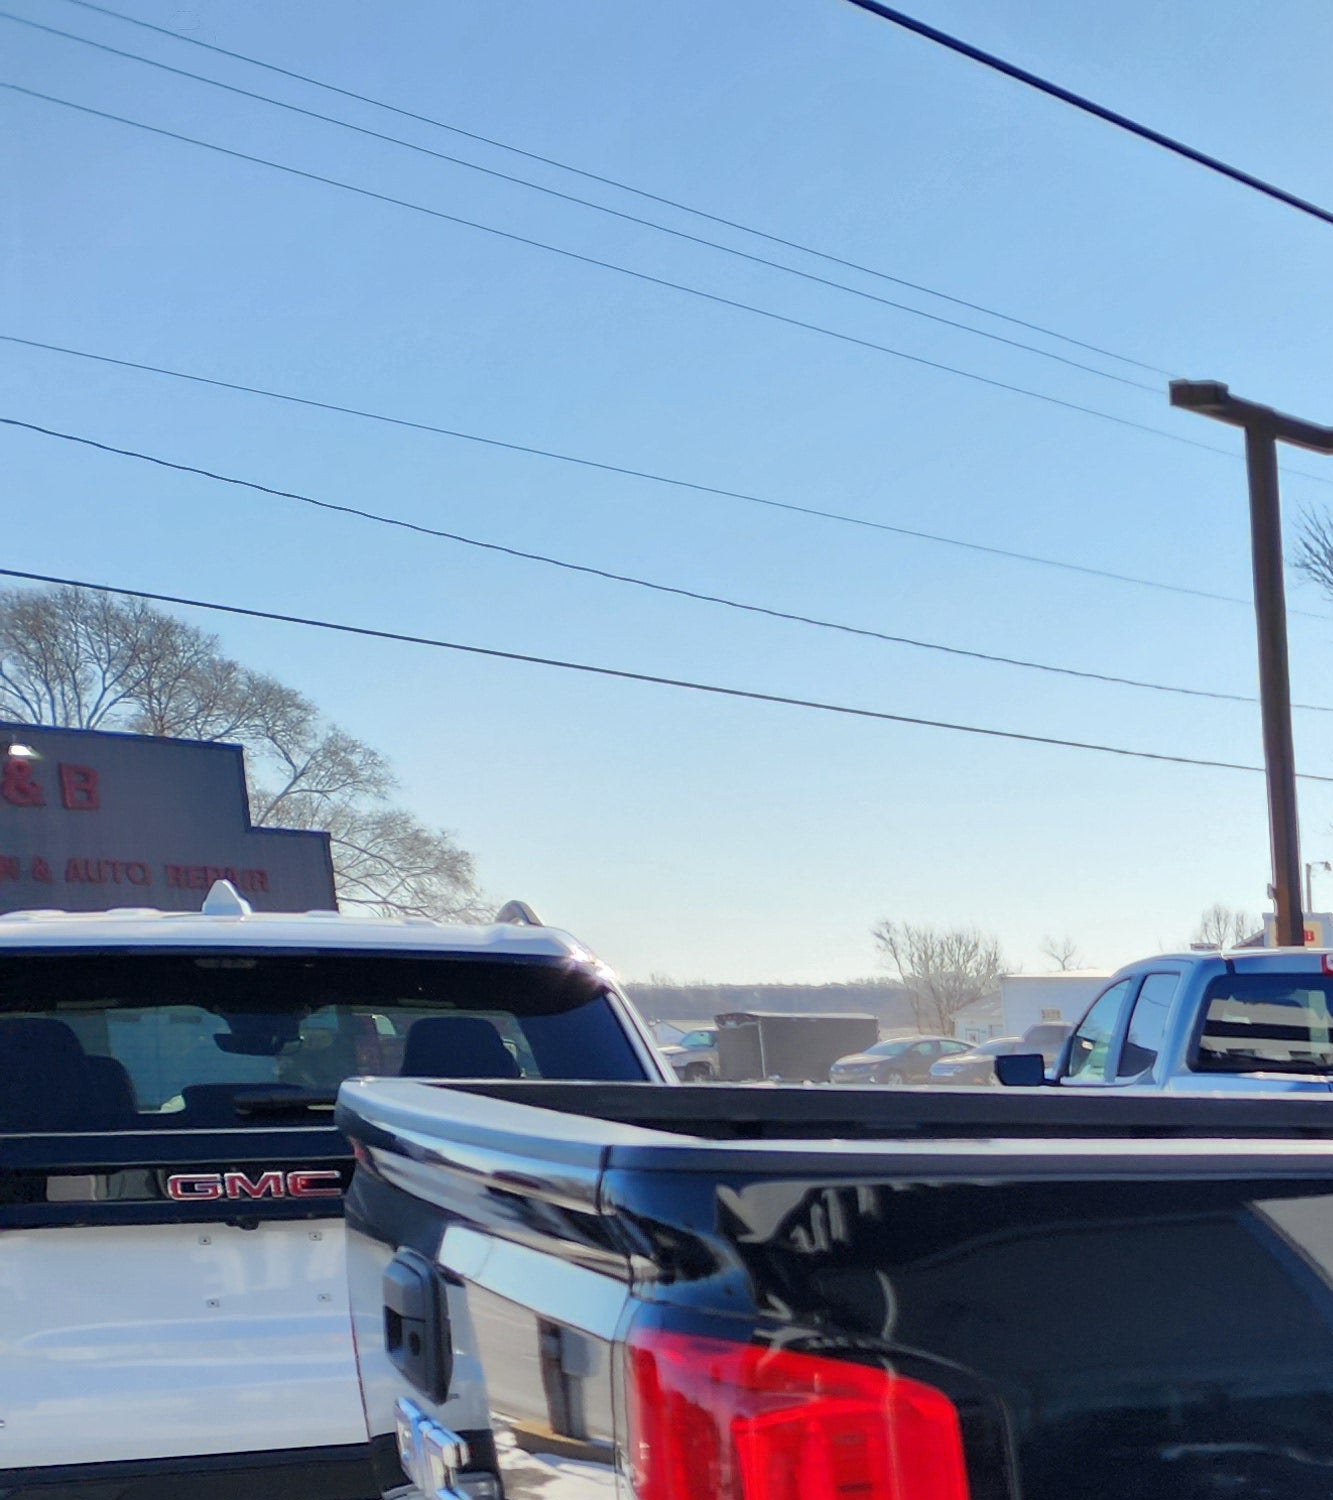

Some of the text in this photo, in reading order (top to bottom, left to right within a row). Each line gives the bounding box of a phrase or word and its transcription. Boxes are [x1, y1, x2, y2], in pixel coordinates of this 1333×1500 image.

[1, 760, 46, 807] &
[65, 857, 151, 887] AUTO
[166, 1170, 343, 1201] GMC
